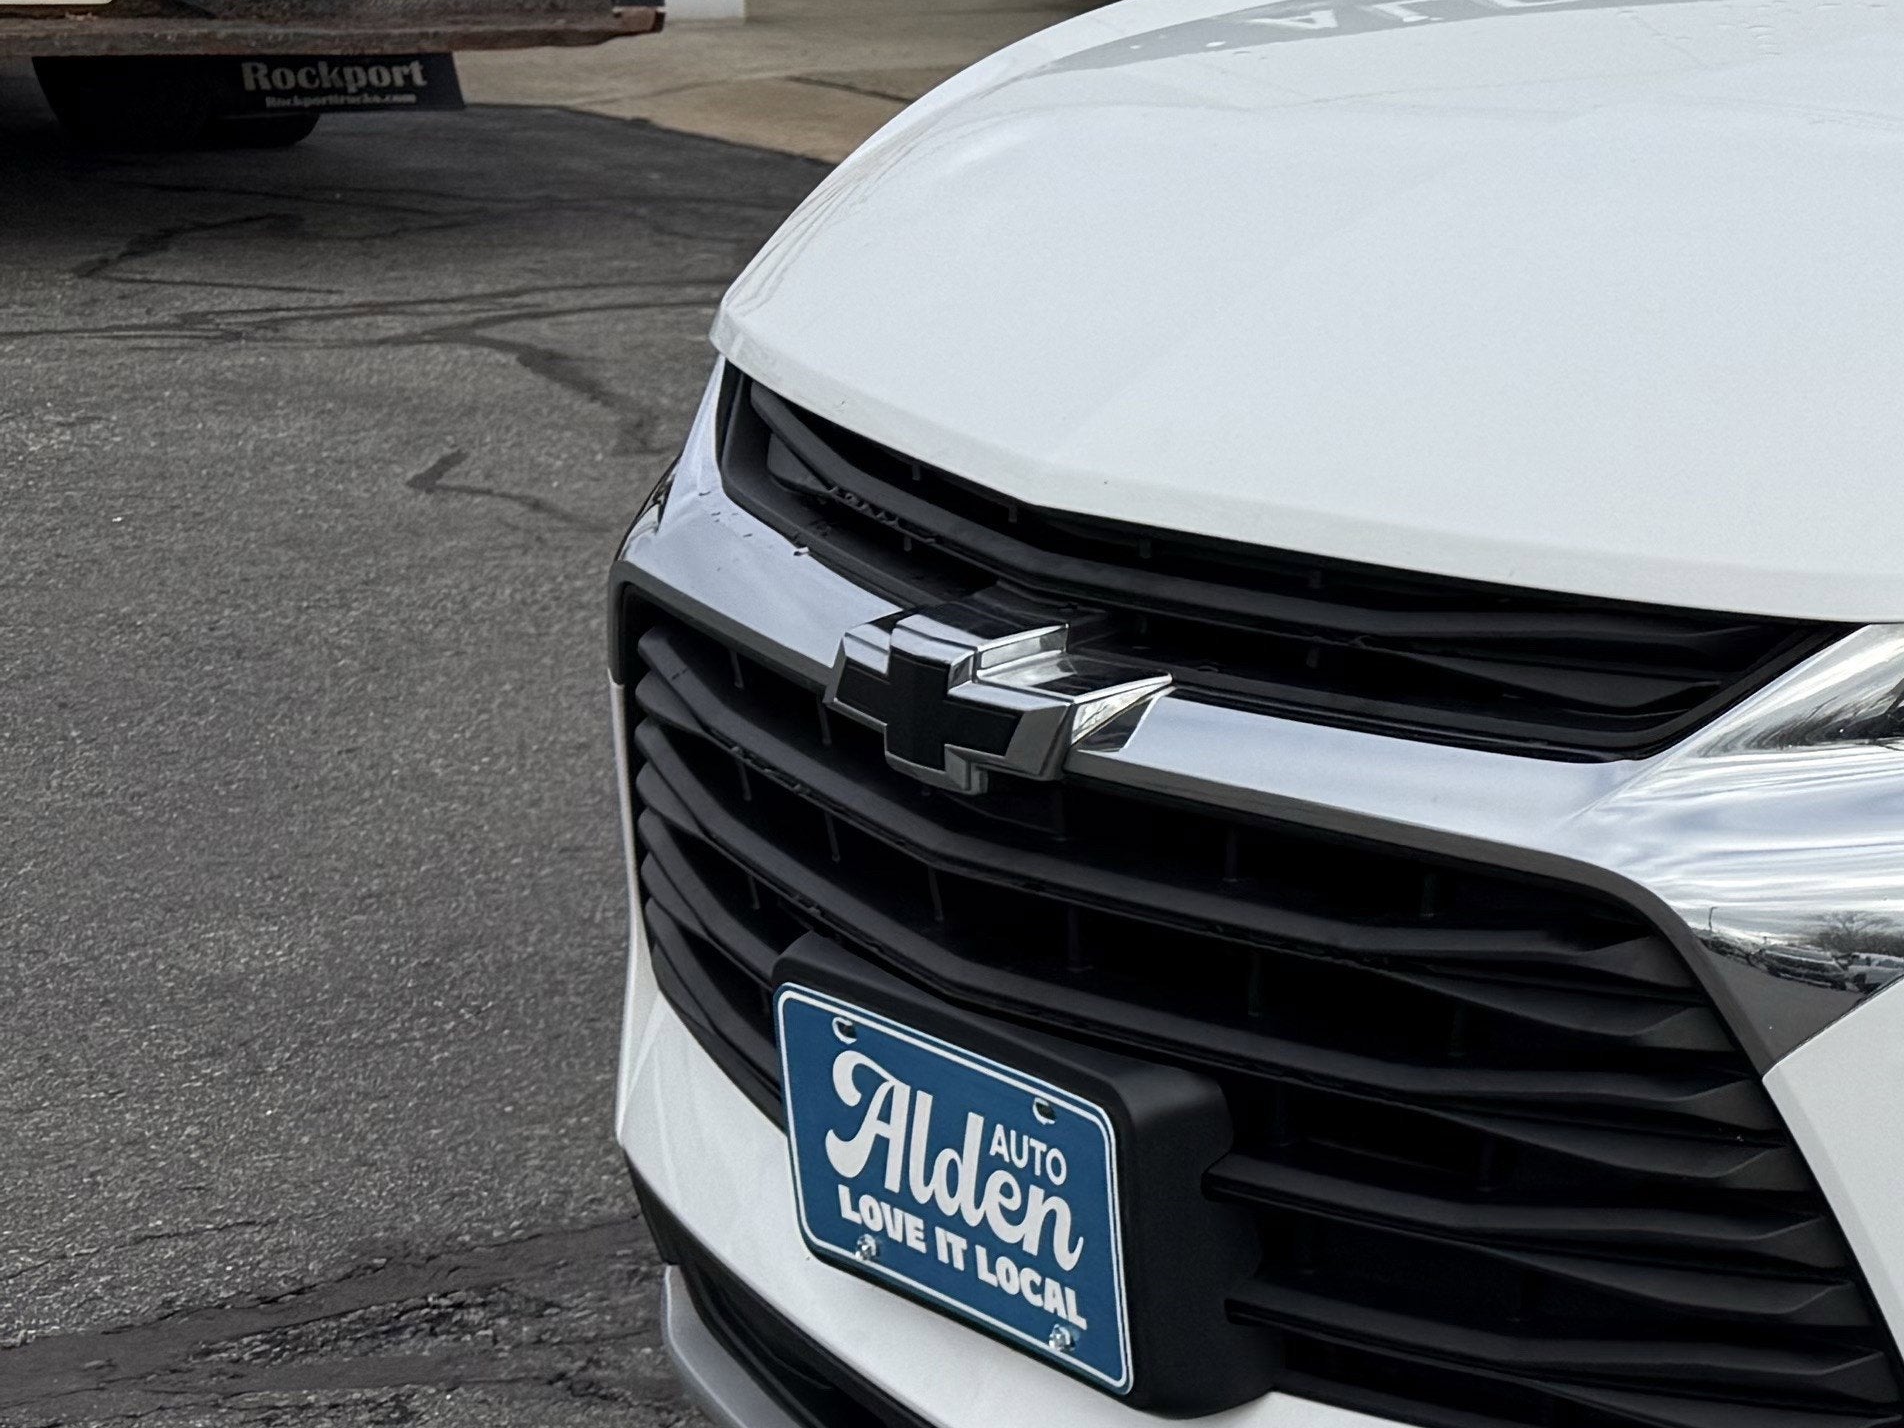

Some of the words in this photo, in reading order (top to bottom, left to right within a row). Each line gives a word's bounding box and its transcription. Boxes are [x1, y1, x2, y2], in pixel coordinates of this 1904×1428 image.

[241, 59, 429, 93] Rockport
[825, 1049, 1085, 1272] Alden
[989, 1122, 1068, 1186] AUTO
[837, 1183, 928, 1253] LOVE
[935, 1228, 968, 1271] IT
[974, 1244, 1088, 1331] LOCAL
